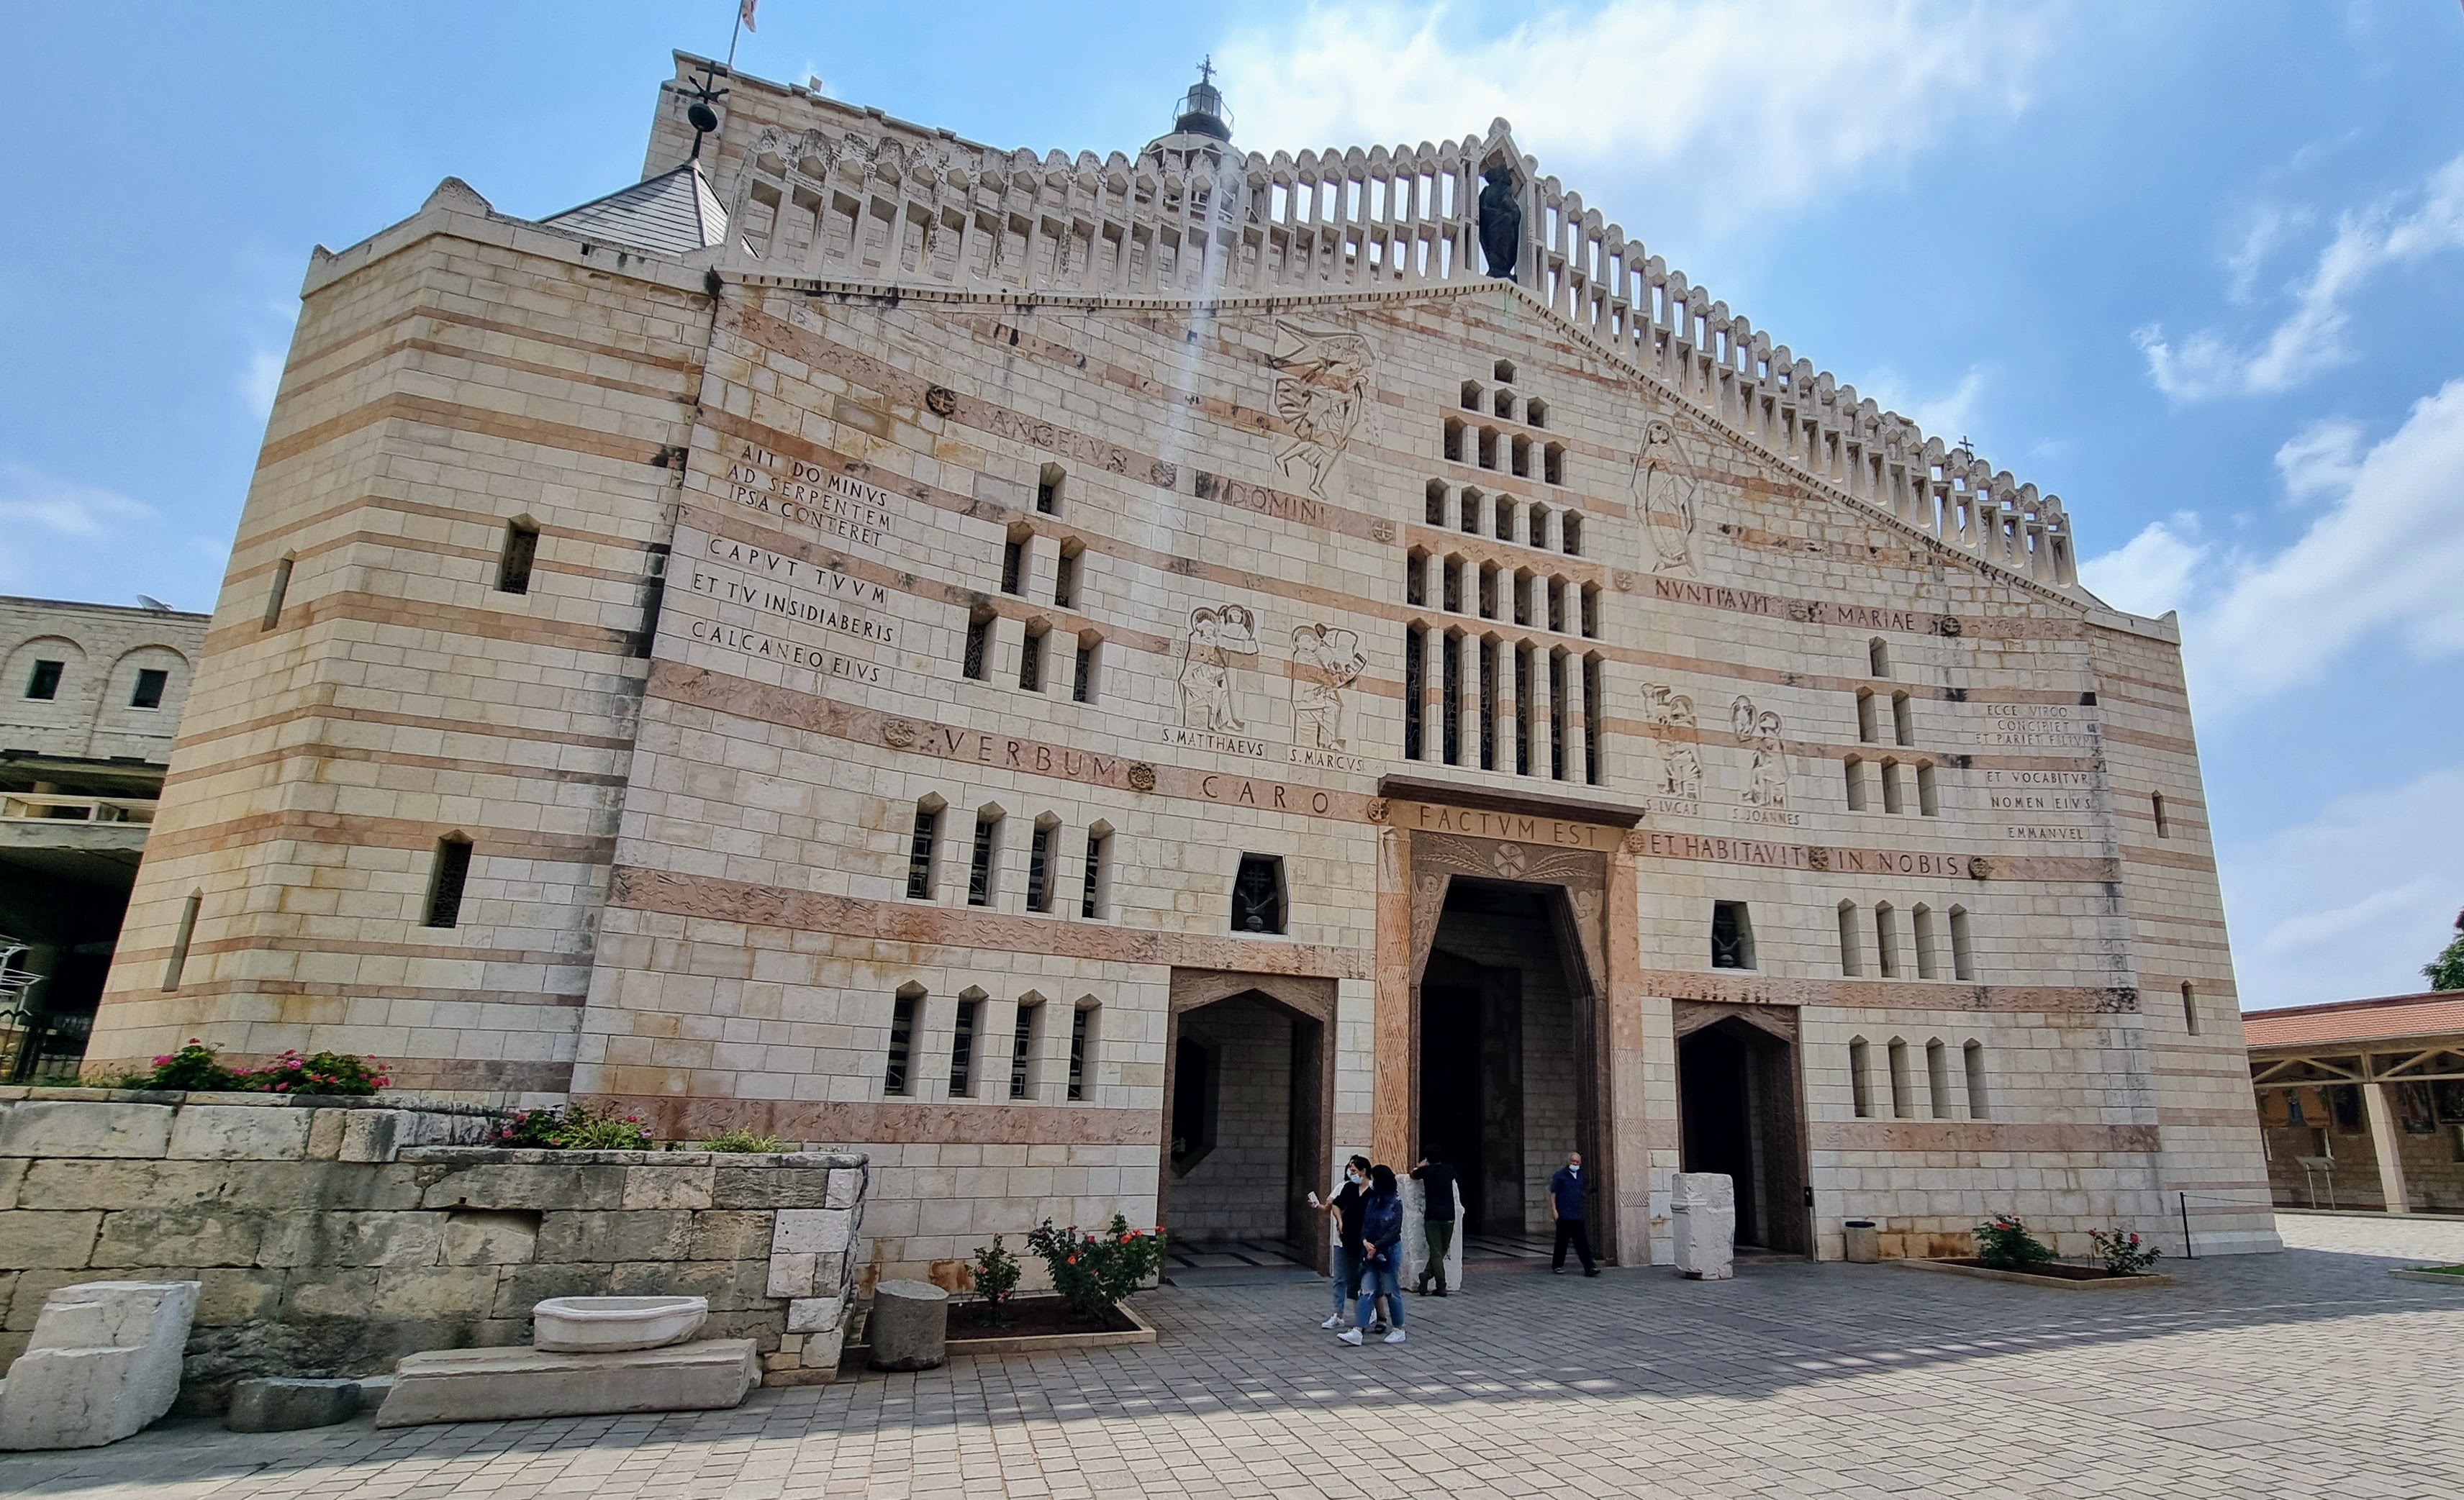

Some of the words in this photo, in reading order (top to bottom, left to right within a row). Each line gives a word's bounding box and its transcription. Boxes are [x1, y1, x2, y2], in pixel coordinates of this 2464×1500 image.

[741, 445, 776, 468] AIT
[792, 461, 888, 507] DOMINVS
[988, 409, 1128, 473] ANGELVS
[1231, 483, 1326, 523] DOMINI
[727, 463, 756, 483] AD
[769, 476, 892, 531] SERPENTEM
[729, 486, 769, 512] IPSA
[781, 501, 882, 547] CONTERET
[710, 538, 798, 578] CAPVT
[816, 570, 886, 604] TVVM
[692, 573, 720, 593] ET
[728, 582, 756, 604] TV
[764, 592, 893, 642] INSIDIABERIS
[1655, 578, 1771, 614] NVNTIAVIT
[1837, 605, 1916, 632] MARIAE
[692, 621, 824, 668] CALCANEO
[833, 658, 880, 682] EIVS
[1987, 705, 2018, 717] ECCE
[1998, 719, 2070, 733] CONCIPIET
[1975, 733, 1989, 745] ET
[1996, 734, 2042, 745] PARIET
[944, 728, 1116, 784] VERBUM
[1202, 776, 1330, 814] CARO
[1987, 771, 2002, 783] ET
[2012, 772, 2088, 785] VOCABITVR
[1419, 805, 1535, 840] FACTVM
[1553, 822, 1598, 847] EST
[1991, 796, 2044, 809] NOMEN
[2056, 799, 2091, 810] EIVS
[1651, 833, 1679, 856] ET
[1685, 836, 1803, 866] HABITAVIT
[1839, 851, 1863, 870] IN
[1878, 852, 1959, 876] NOBIS
[2008, 827, 2084, 840] EMMANVEL
